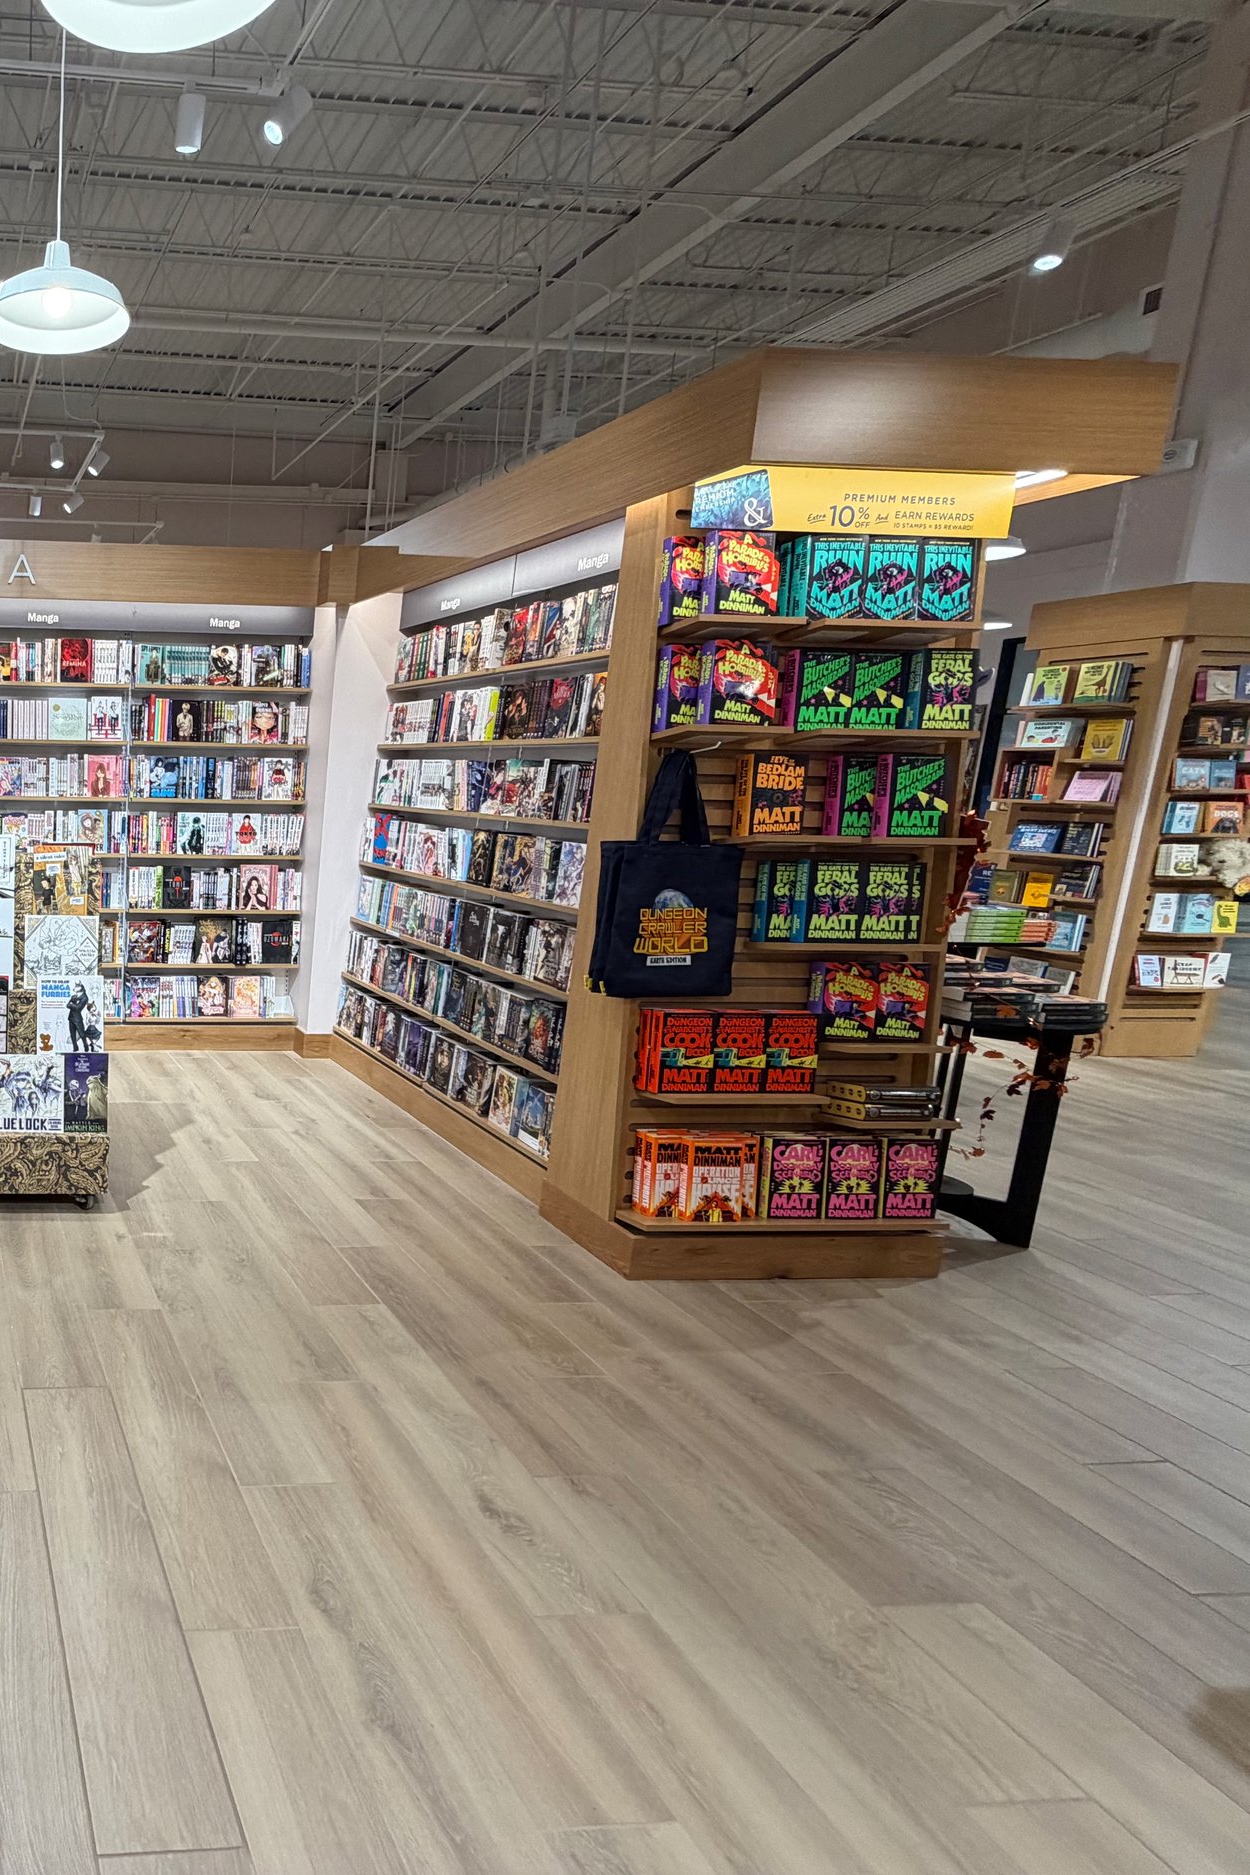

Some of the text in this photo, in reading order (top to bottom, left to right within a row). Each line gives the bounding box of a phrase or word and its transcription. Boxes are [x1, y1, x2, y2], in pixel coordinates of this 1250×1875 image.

[844, 493, 956, 506] PREMIUM MEMBERS
[807, 505, 870, 528] Extra 10 %
[894, 510, 974, 522] EARN REWARDS
[855, 521, 870, 529] OFF
[902, 522, 926, 530] STAMPS
[744, 534, 753, 545] A
[814, 542, 866, 551] THIS INEVITABLE
[577, 552, 609, 571] Manga
[813, 551, 864, 577] RUIN
[729, 590, 756, 603] MATT
[810, 580, 863, 609] MATT
[440, 597, 461, 611] Manga
[719, 600, 766, 615] DINNIMAN
[809, 597, 860, 619] DINNIMAN
[27, 612, 59, 625] Manga
[209, 617, 241, 630] Manga
[931, 659, 972, 672] FERAL
[928, 671, 973, 687] GODS
[922, 704, 973, 721] MATT
[921, 720, 970, 730] DINNIMAN
[758, 763, 805, 777] BEDLAM
[896, 759, 946, 790] BUTCHER'S
[897, 764, 911, 774] THE
[756, 774, 805, 791] BRIDE
[753, 806, 803, 824] MATT
[891, 810, 943, 827] MATT
[753, 822, 800, 833] DINNIMAN
[890, 827, 939, 836] DINNIMAN
[640, 907, 708, 920] DUNGEON
[638, 921, 707, 935] CRAWLER
[633, 936, 708, 954] WORLD
[666, 1017, 713, 1026] DUNGEON
[663, 1068, 709, 1083] MATT
[661, 1083, 708, 1092] DINNIMAN
[20, 1118, 47, 1131] LOCK
[694, 1146, 742, 1156] MATT
[773, 1144, 823, 1162] CARL'S
[693, 1155, 742, 1167] DINNIMAN
[693, 1166, 741, 1178] OPERATION
[770, 1193, 820, 1208] MATT
[770, 1208, 817, 1217] DINNIMAN
